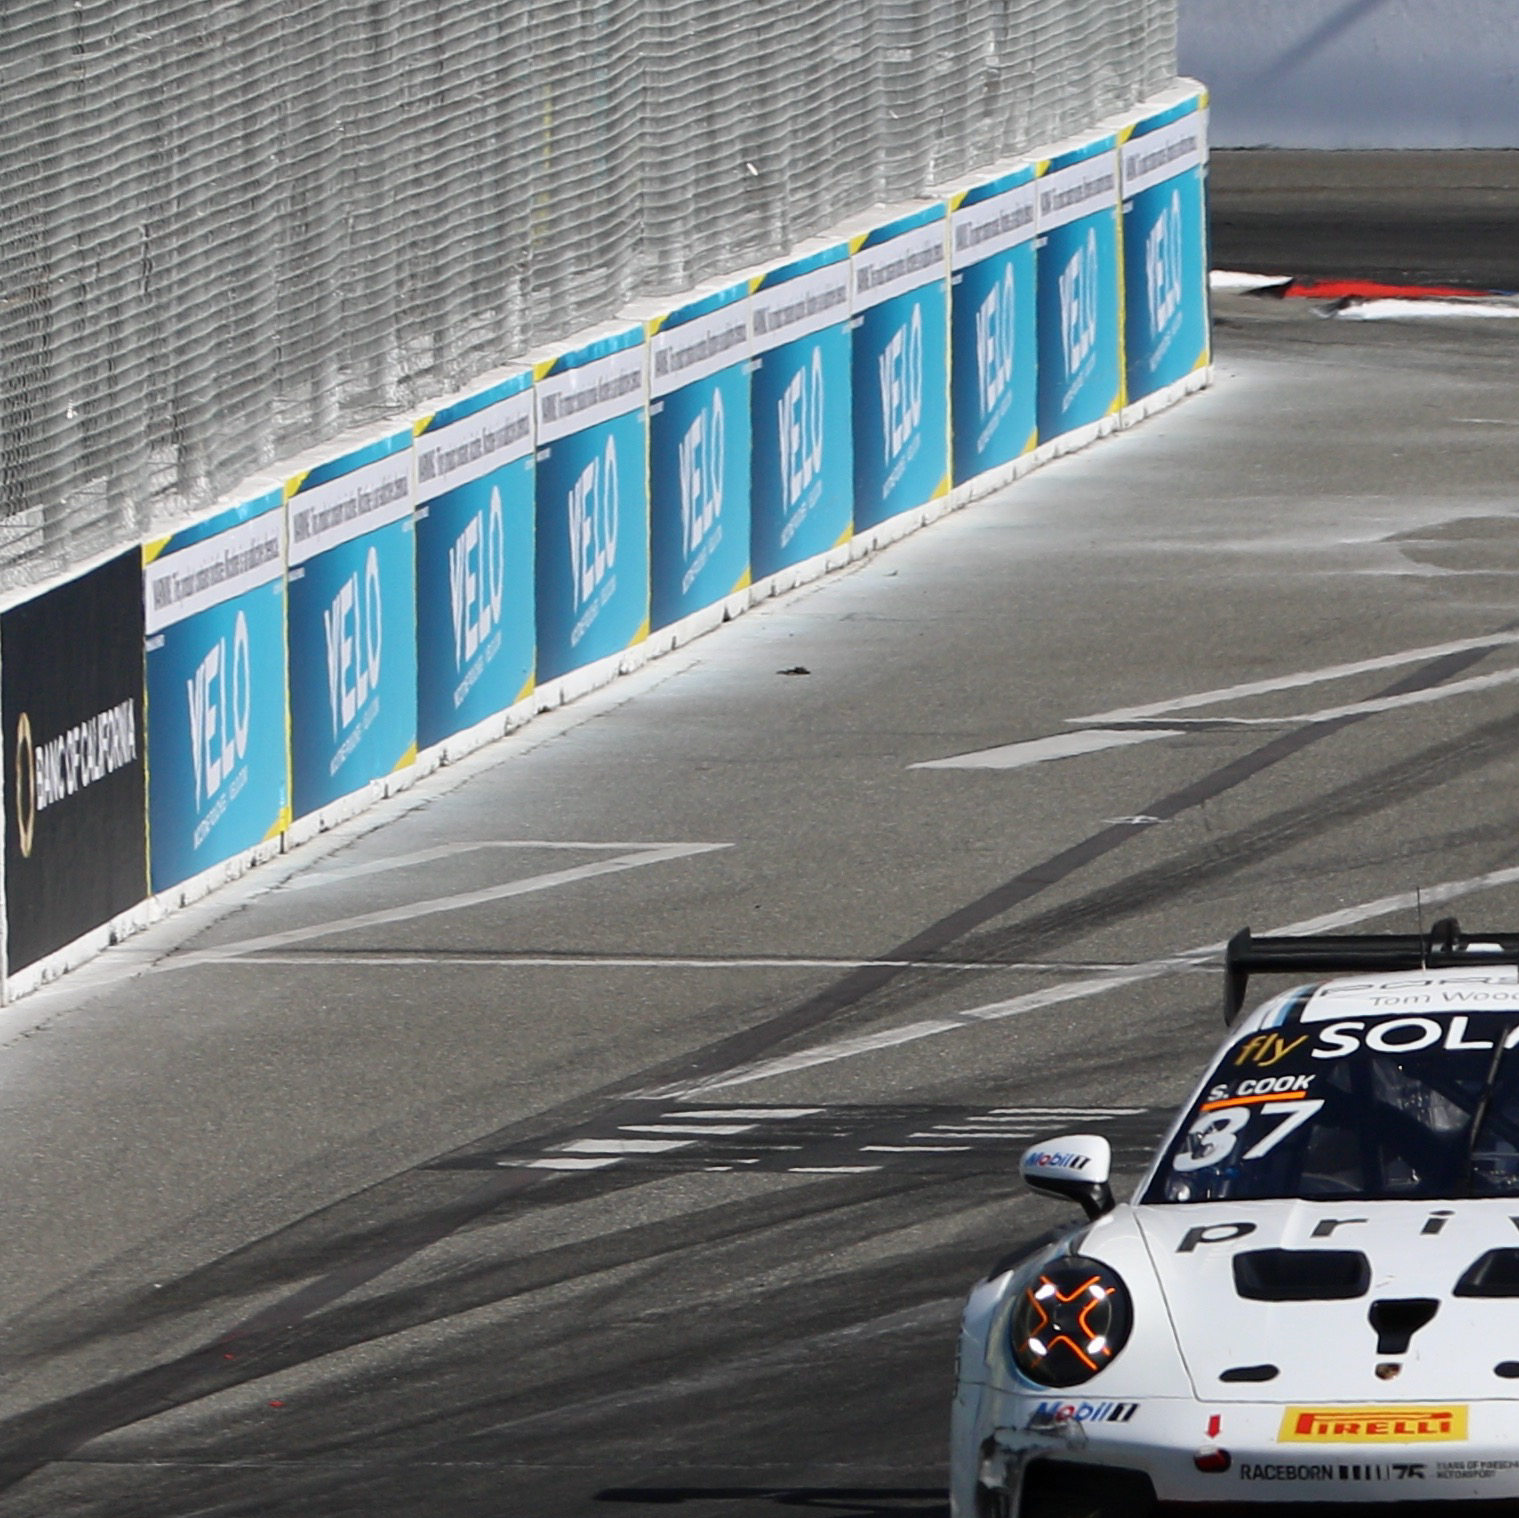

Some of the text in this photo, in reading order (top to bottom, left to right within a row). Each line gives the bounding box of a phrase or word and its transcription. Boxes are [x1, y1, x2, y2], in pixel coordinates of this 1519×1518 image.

[879, 303, 922, 467] VELO
[976, 262, 1015, 422] VELO
[679, 387, 724, 562] VELO
[777, 346, 823, 515] VELO
[449, 485, 504, 674] VELO
[569, 434, 618, 615] VELO
[187, 610, 250, 814] VELO
[324, 546, 382, 743] VELO
[1235, 1033, 1309, 1067] fly
[1370, 993, 1431, 1007] Tom
[1024, 1152, 1072, 1169] Mobil
[1173, 1100, 1326, 1173] 37
[1208, 1074, 1316, 1101] S. COOK
[1240, 1463, 1334, 1481] RACEBORN
[1295, 1411, 1453, 1435] PIRELLI
